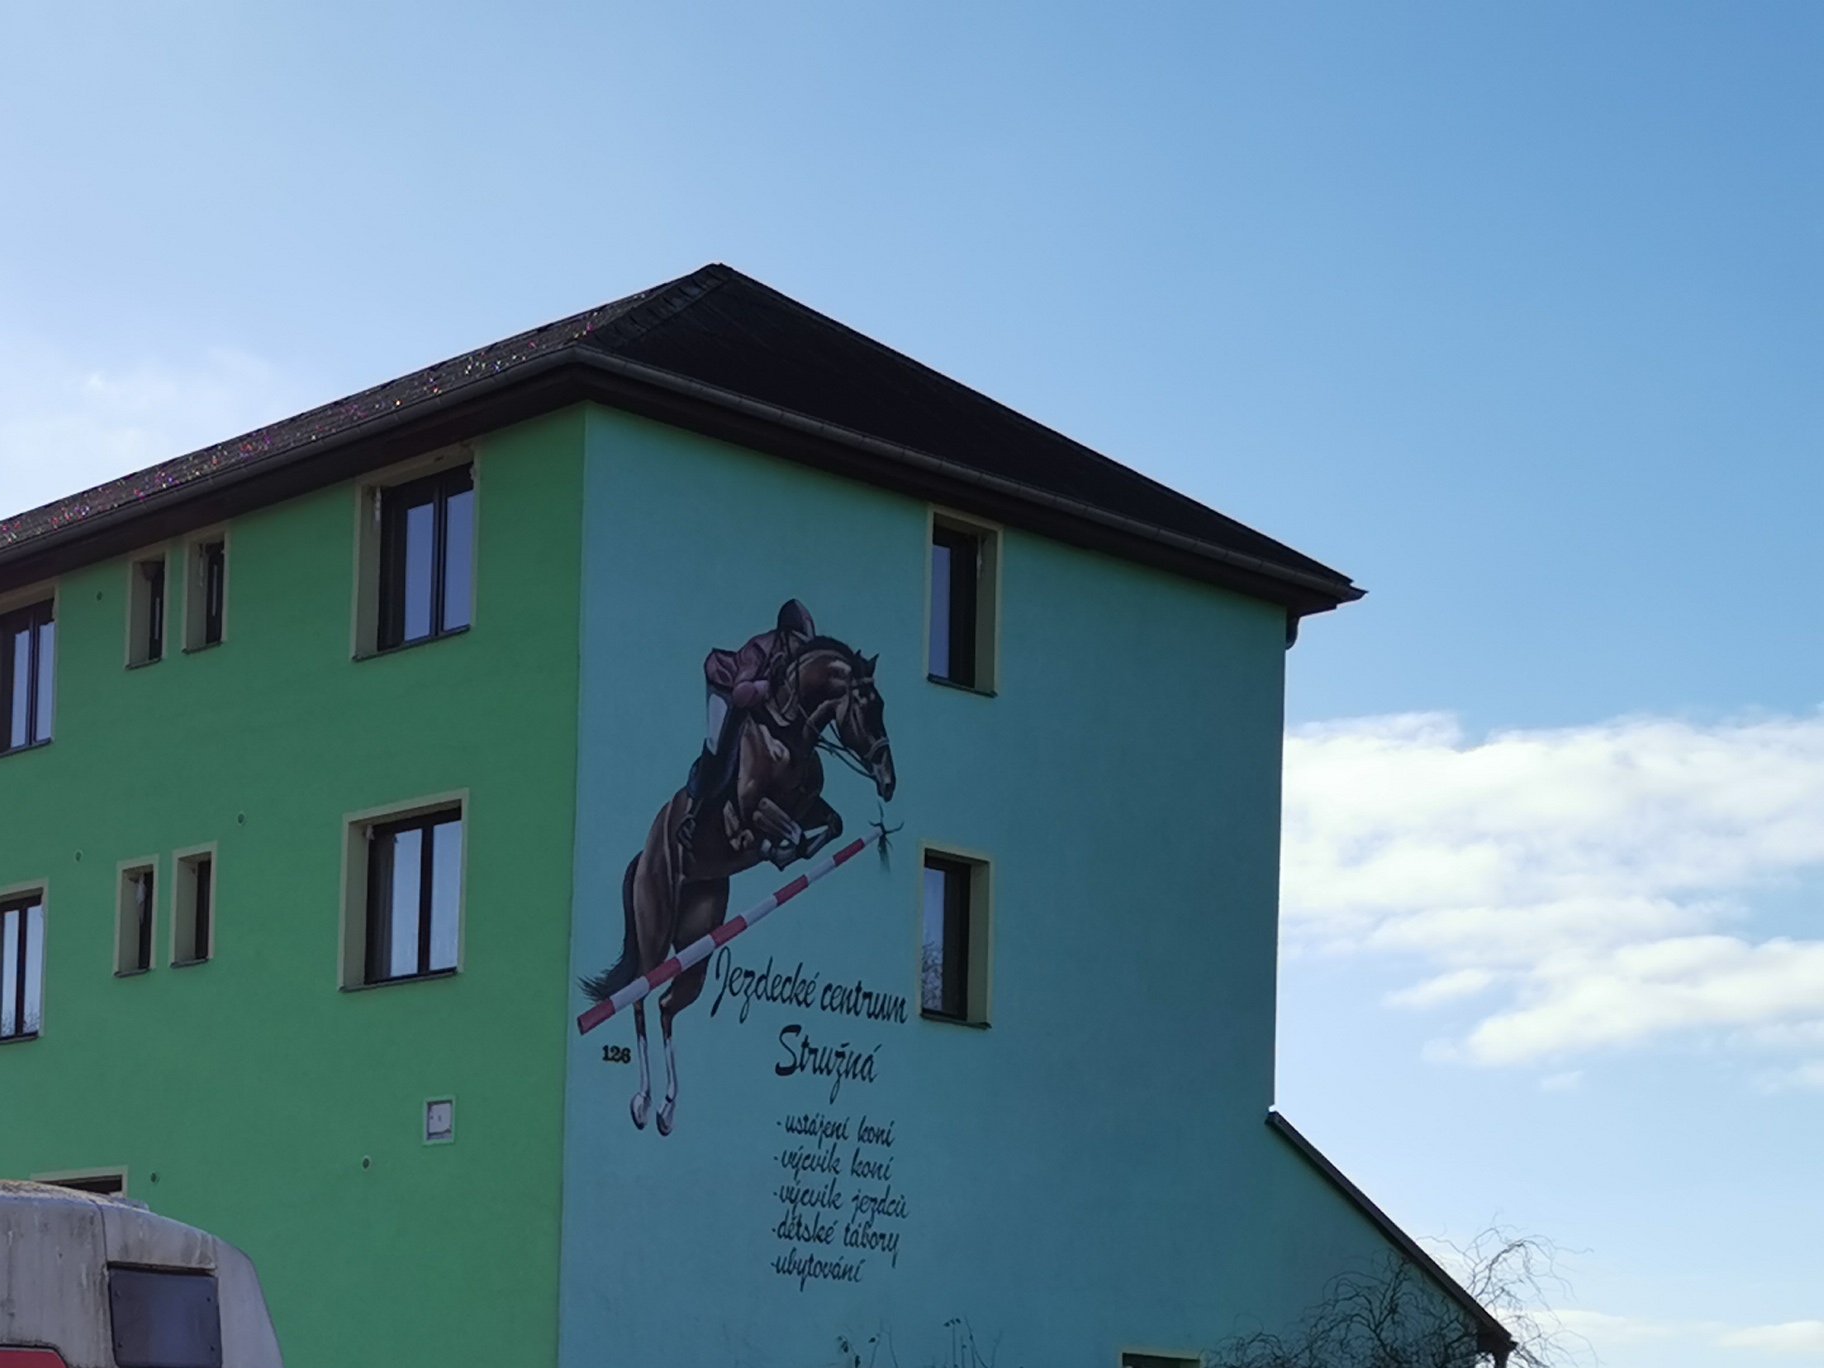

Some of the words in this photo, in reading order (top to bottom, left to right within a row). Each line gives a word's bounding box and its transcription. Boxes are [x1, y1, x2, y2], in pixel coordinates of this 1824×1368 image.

[710, 946, 820, 1024] Jezdecké
[820, 980, 909, 1024] centrum
[775, 1024, 882, 1105] Stružná
[857, 1115, 895, 1147] koní
[850, 1147, 894, 1181] koní
[843, 1221, 900, 1269] tábory
